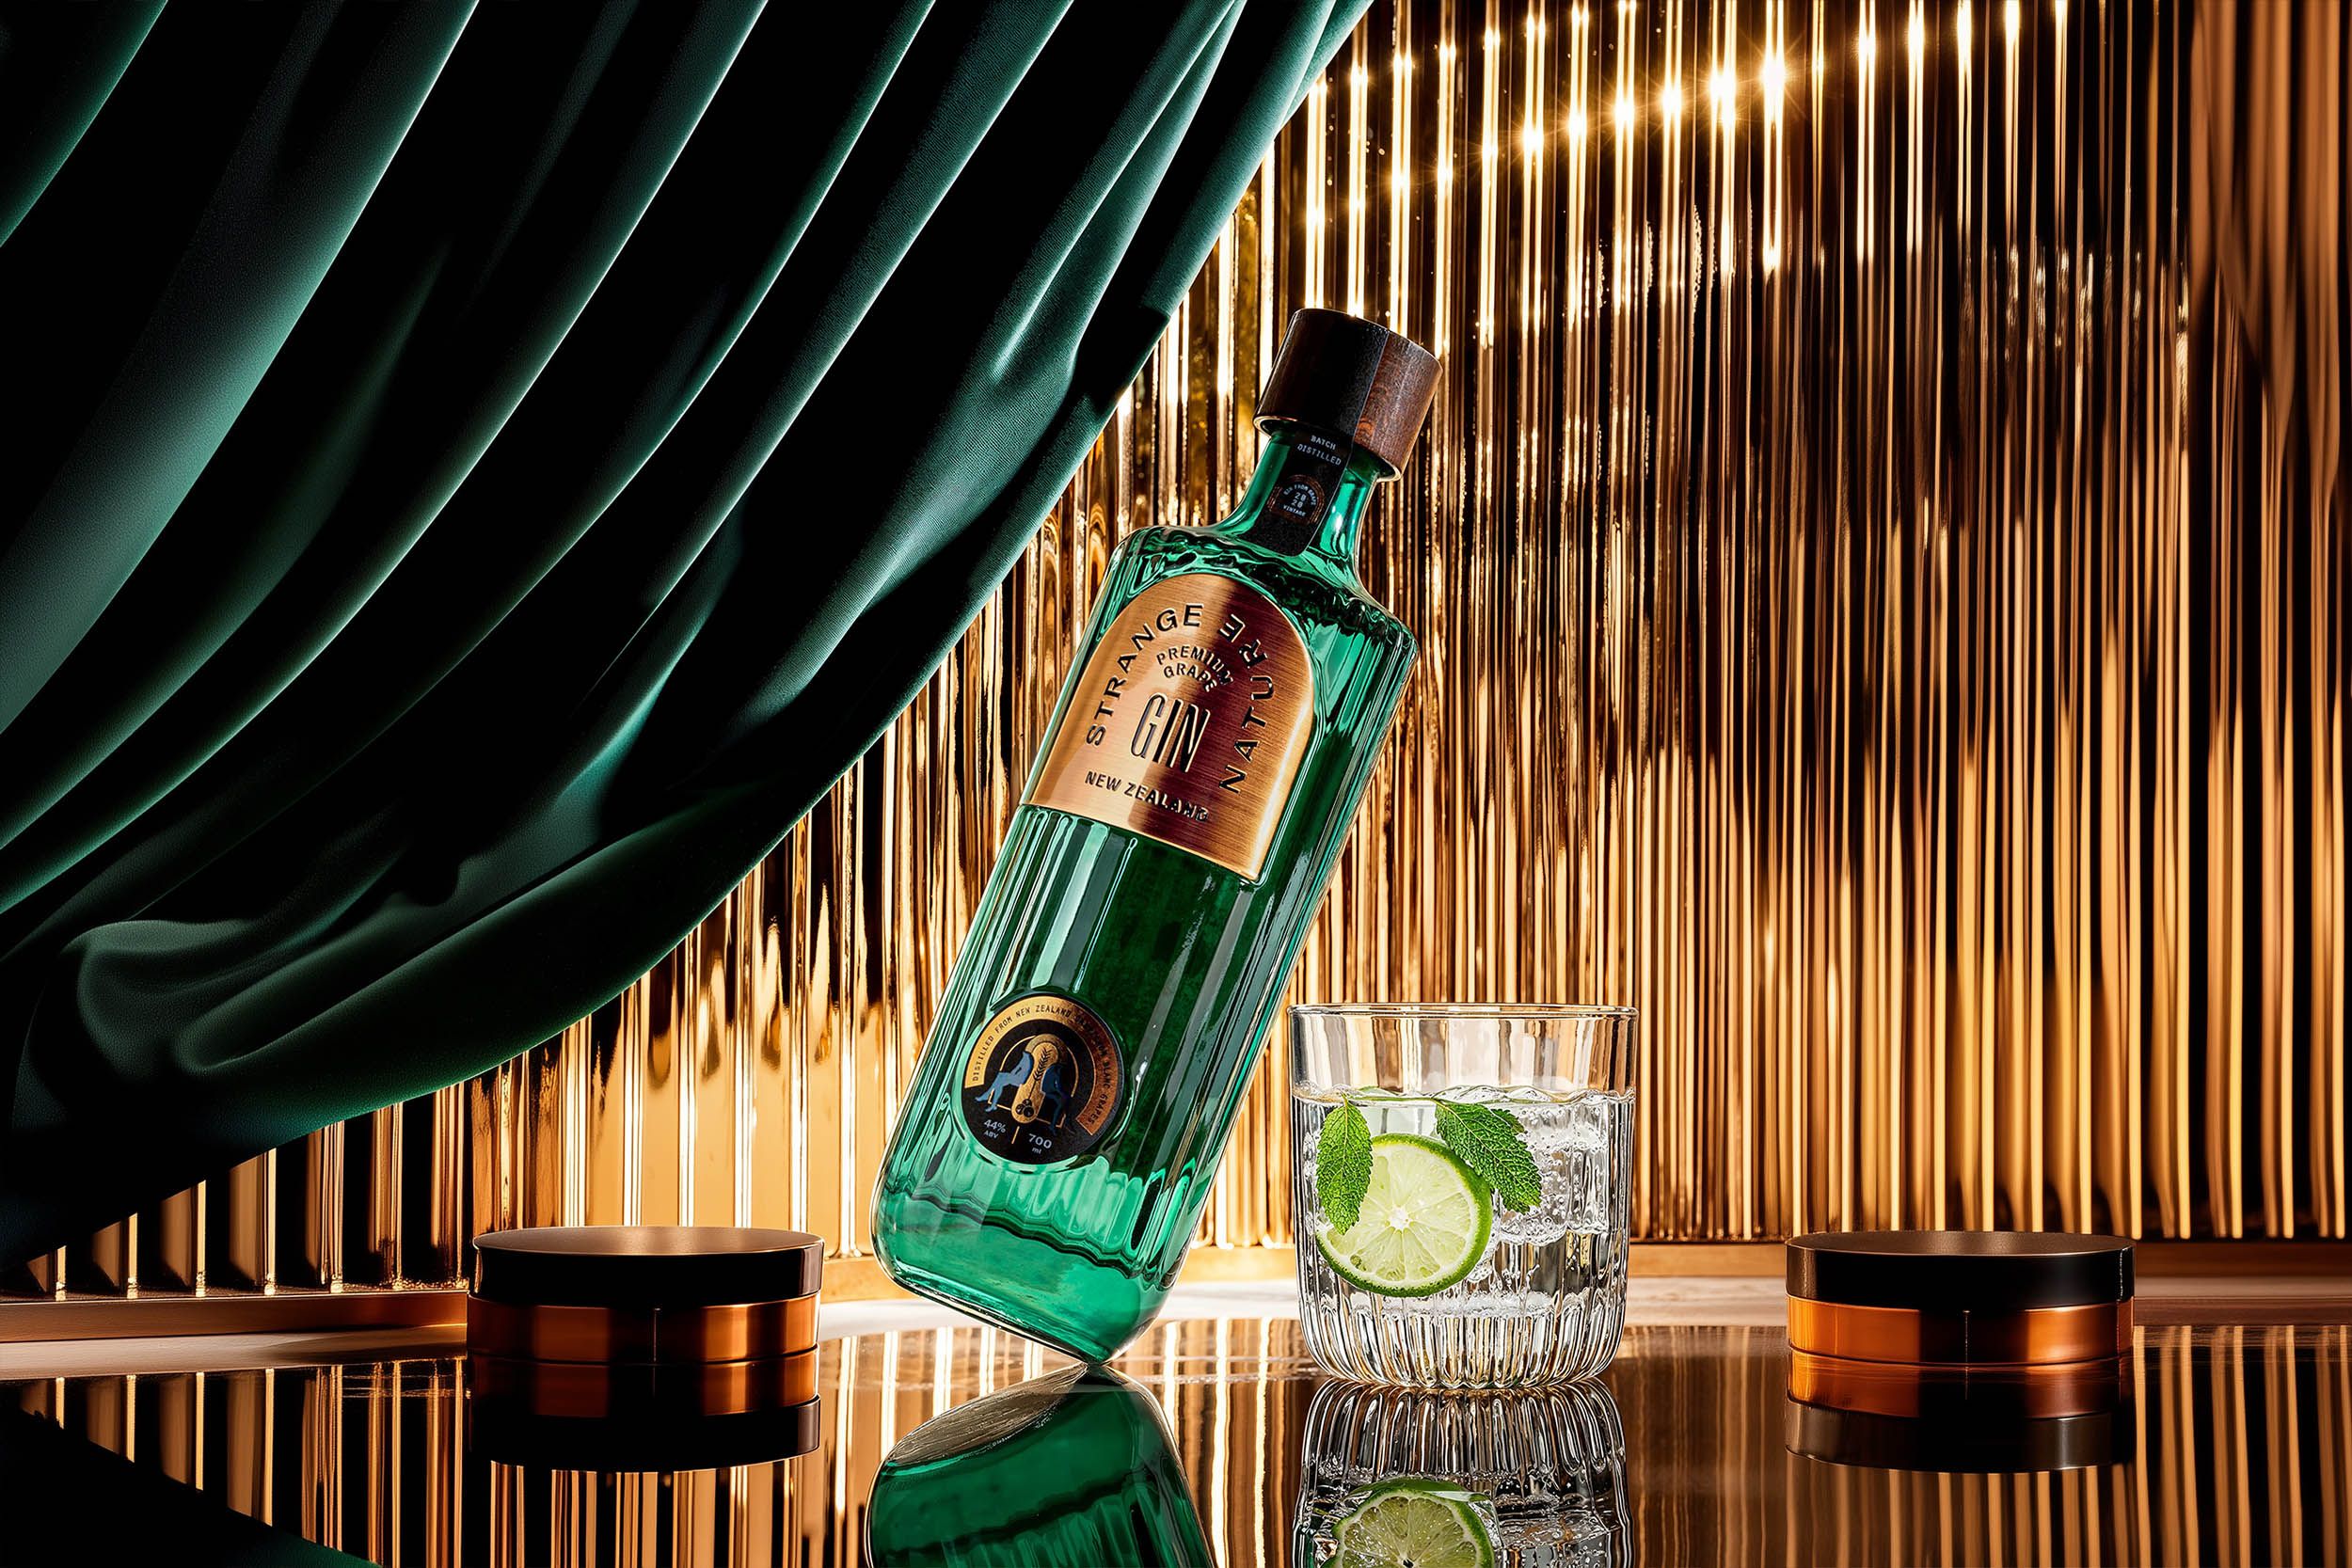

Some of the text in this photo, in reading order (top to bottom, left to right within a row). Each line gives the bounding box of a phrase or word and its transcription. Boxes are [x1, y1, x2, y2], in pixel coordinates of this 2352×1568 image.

[1297, 443, 1342, 466] DISTILLED
[1311, 435, 1336, 450] BATCH
[1086, 603, 1204, 747] STRANGE
[1156, 644, 1233, 685] PREMIUM
[1164, 662, 1217, 692] GRAPE
[1219, 613, 1274, 794] NATURE
[1130, 692, 1211, 773] GIN
[1085, 770, 1211, 822] NEW ZEALAND
[972, 1036, 994, 1081] DISTILLED
[994, 1016, 1013, 1034] FROM
[1015, 1006, 1031, 1018] NEW
[1036, 1005, 1073, 1018] ZEALAND
[1089, 1093, 1108, 1125] GRAPES
[983, 1119, 1006, 1133] 44%
[984, 1130, 999, 1139] ABV
[1028, 1132, 1053, 1148] 700
